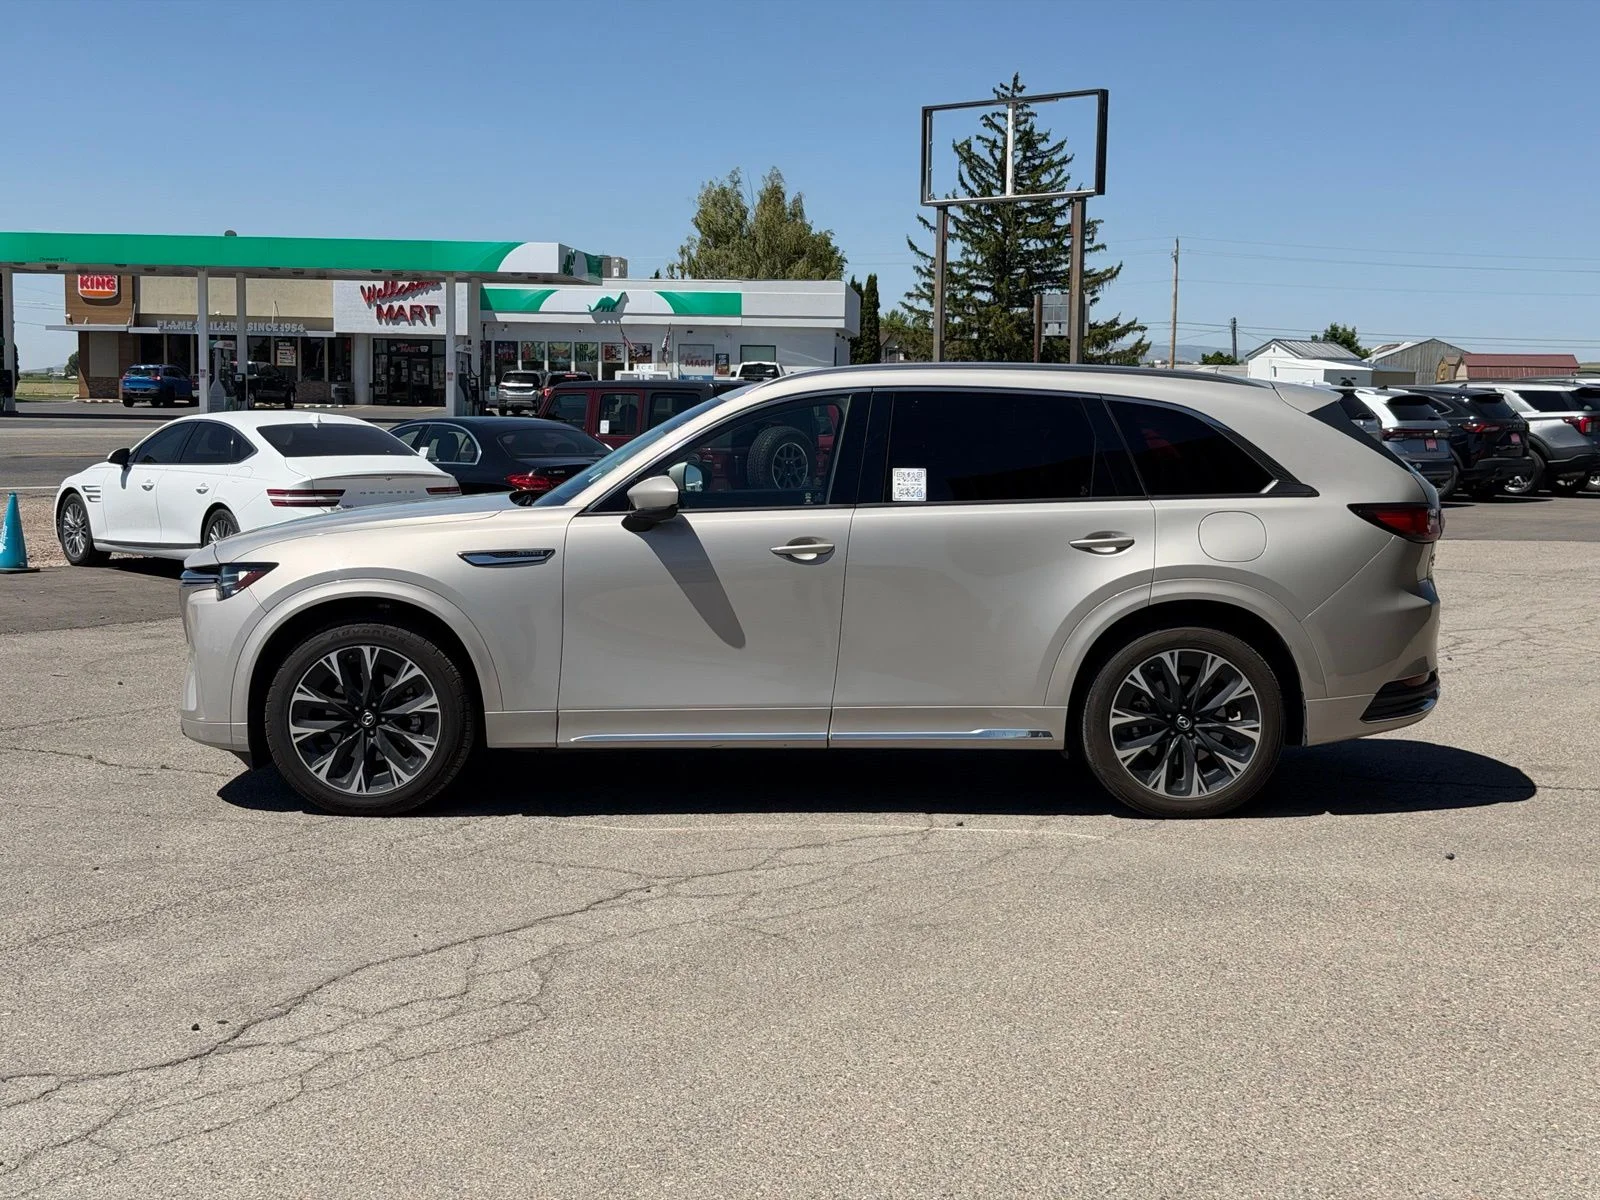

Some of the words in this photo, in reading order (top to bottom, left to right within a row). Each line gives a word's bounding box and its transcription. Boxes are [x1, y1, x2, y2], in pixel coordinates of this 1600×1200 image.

[80, 277, 117, 290] KING
[376, 304, 440, 324] MART
[156, 319, 193, 331] FLAME
[247, 322, 278, 333] SINCE
[279, 323, 306, 333] 1954
[684, 359, 713, 368] MART
